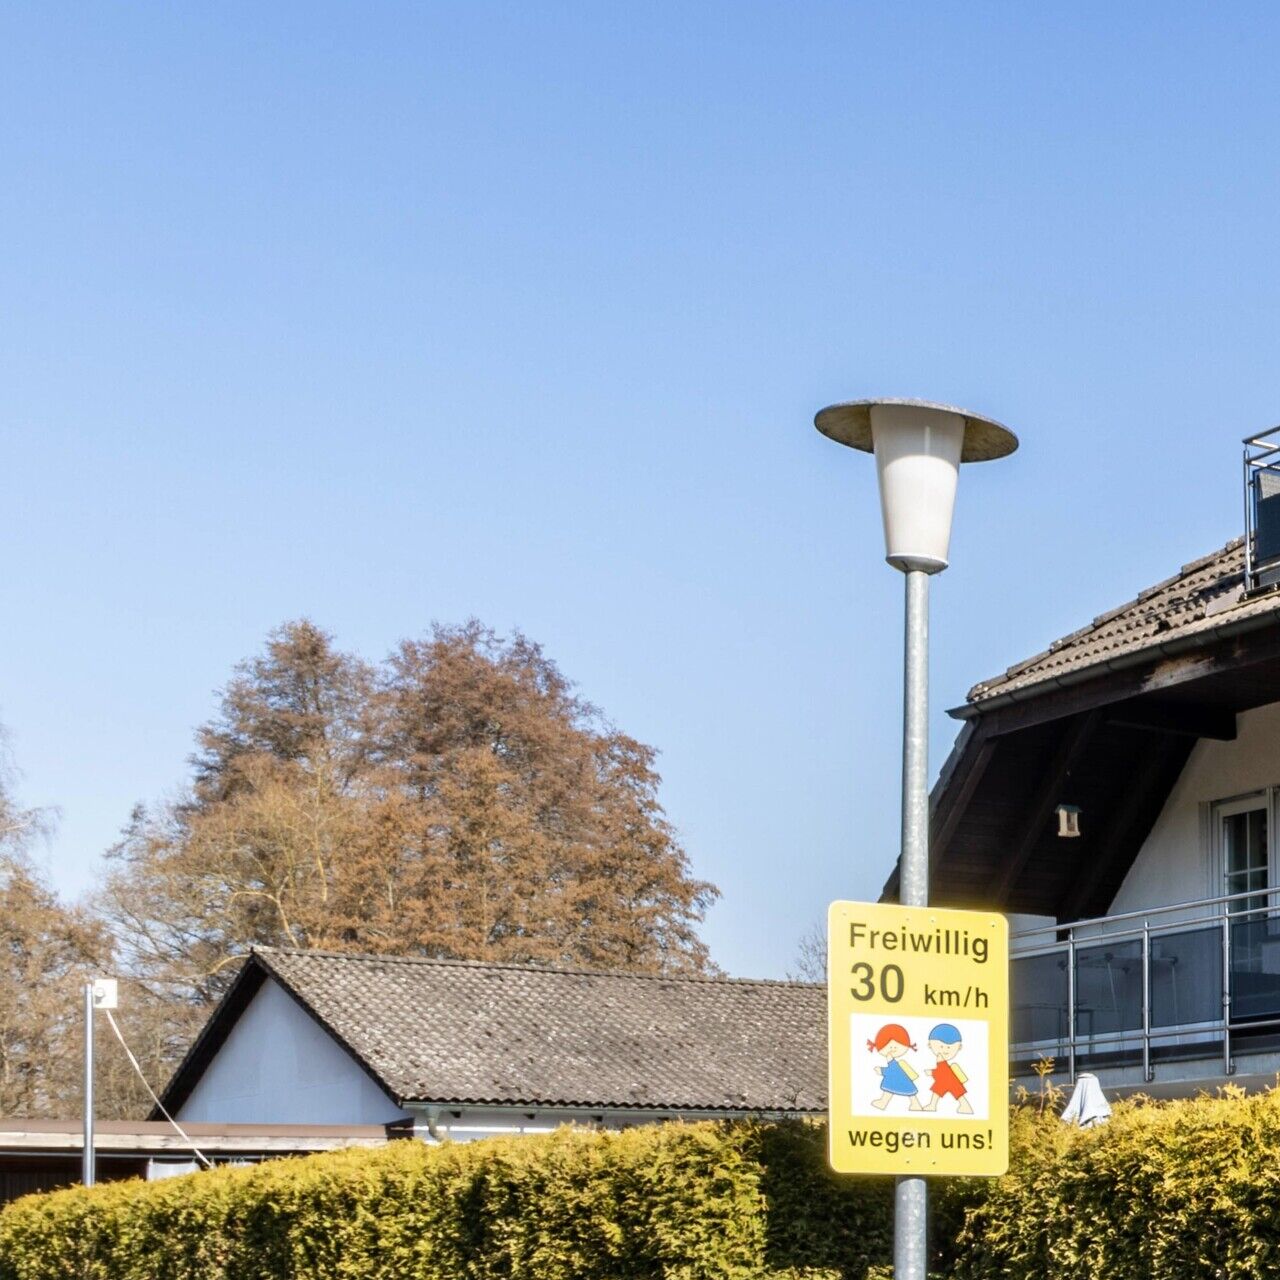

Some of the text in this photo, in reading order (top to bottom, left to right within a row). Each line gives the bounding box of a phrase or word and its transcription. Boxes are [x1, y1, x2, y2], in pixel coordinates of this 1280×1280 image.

[849, 922, 989, 963] Freiwillig
[850, 961, 989, 1008] 30 km/h
[848, 1129, 993, 1153] wegen uns!
